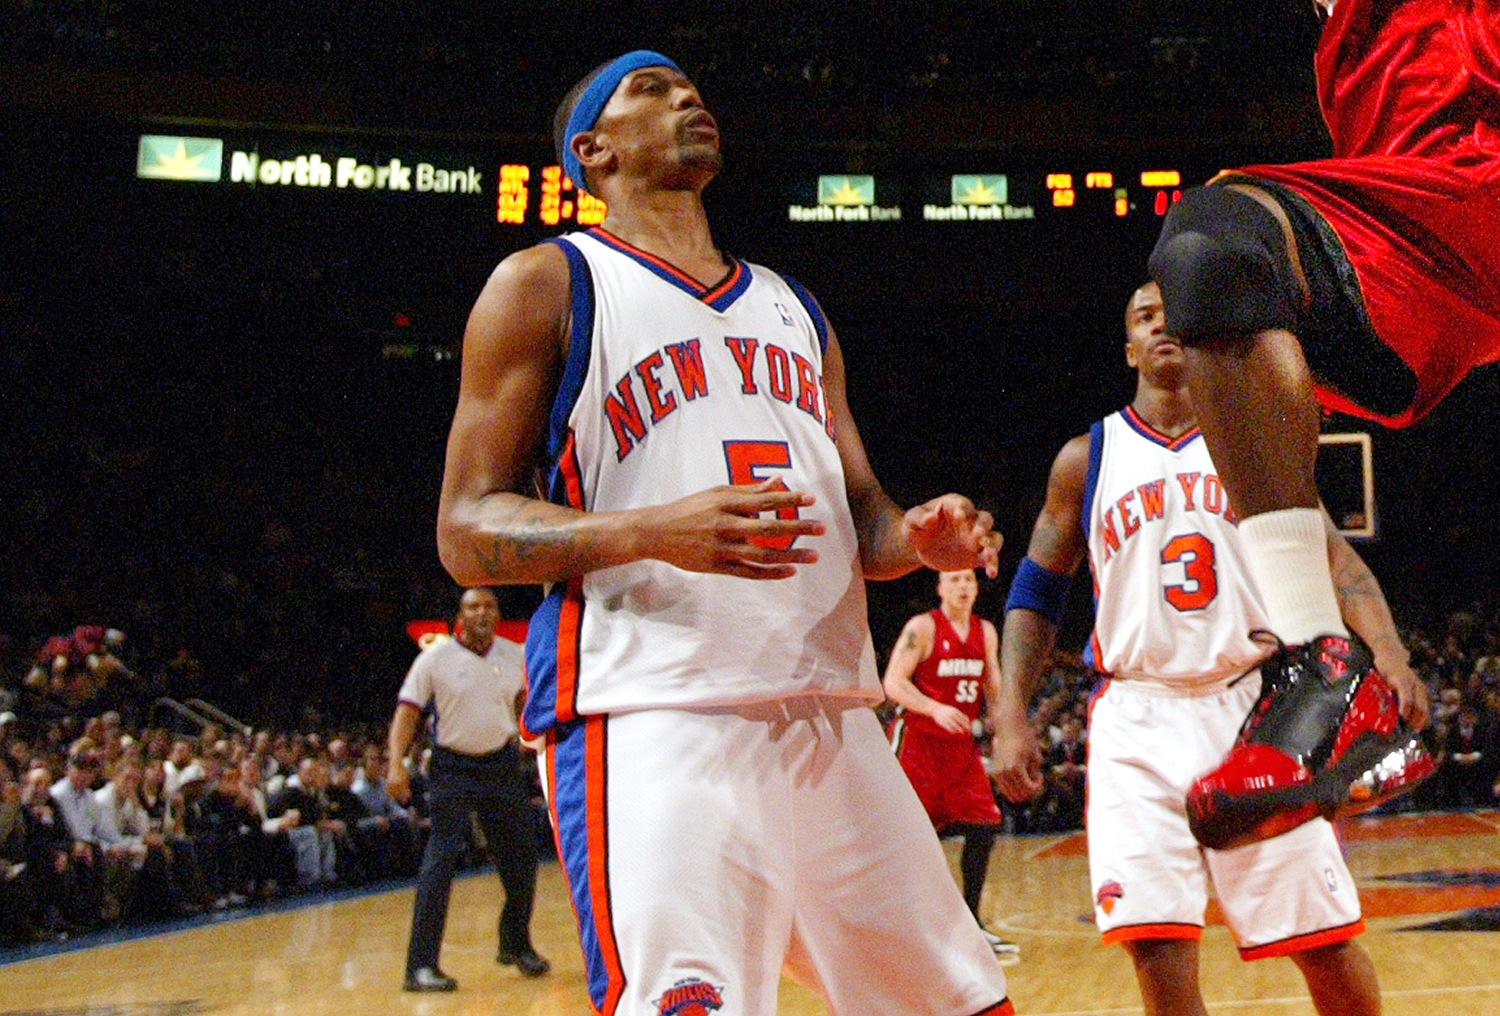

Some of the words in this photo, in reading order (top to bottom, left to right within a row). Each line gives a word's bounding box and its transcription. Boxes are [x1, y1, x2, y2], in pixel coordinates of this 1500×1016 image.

[230, 150, 332, 188] North
[336, 157, 412, 191] Fork
[415, 162, 483, 194] Bank
[603, 336, 710, 464] NEW
[725, 336, 838, 444] YOR
[1102, 478, 1167, 563] NEW
[1160, 531, 1218, 612] 3
[955, 680, 979, 703] 55
